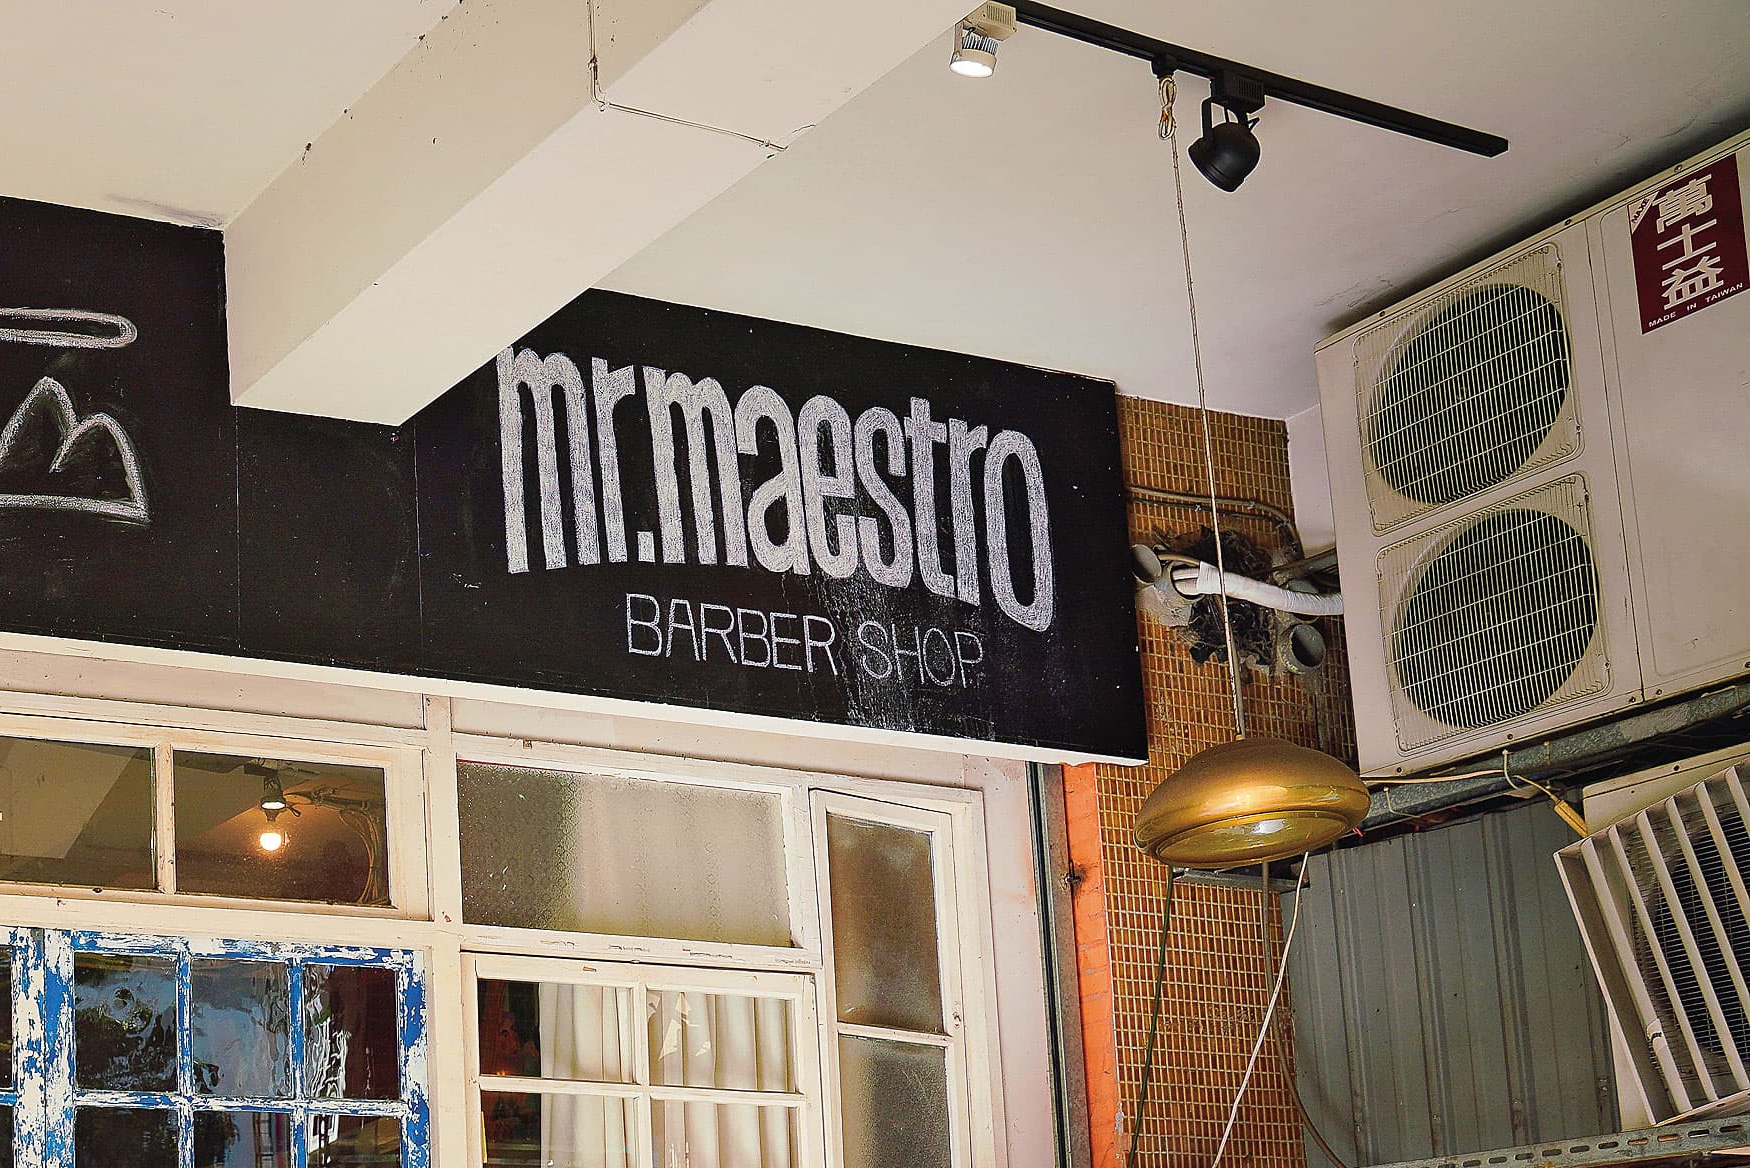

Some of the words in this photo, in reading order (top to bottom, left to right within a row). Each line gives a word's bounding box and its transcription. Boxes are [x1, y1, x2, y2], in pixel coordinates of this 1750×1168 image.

[1651, 174, 1725, 311] 萬士益
[1648, 311, 1677, 328] MADE
[1686, 303, 1698, 312] IN
[1705, 282, 1744, 303] TAIWAN
[496, 345, 1055, 633] mr.maestro
[626, 593, 839, 677] BARBER
[856, 620, 984, 688] SHOP
